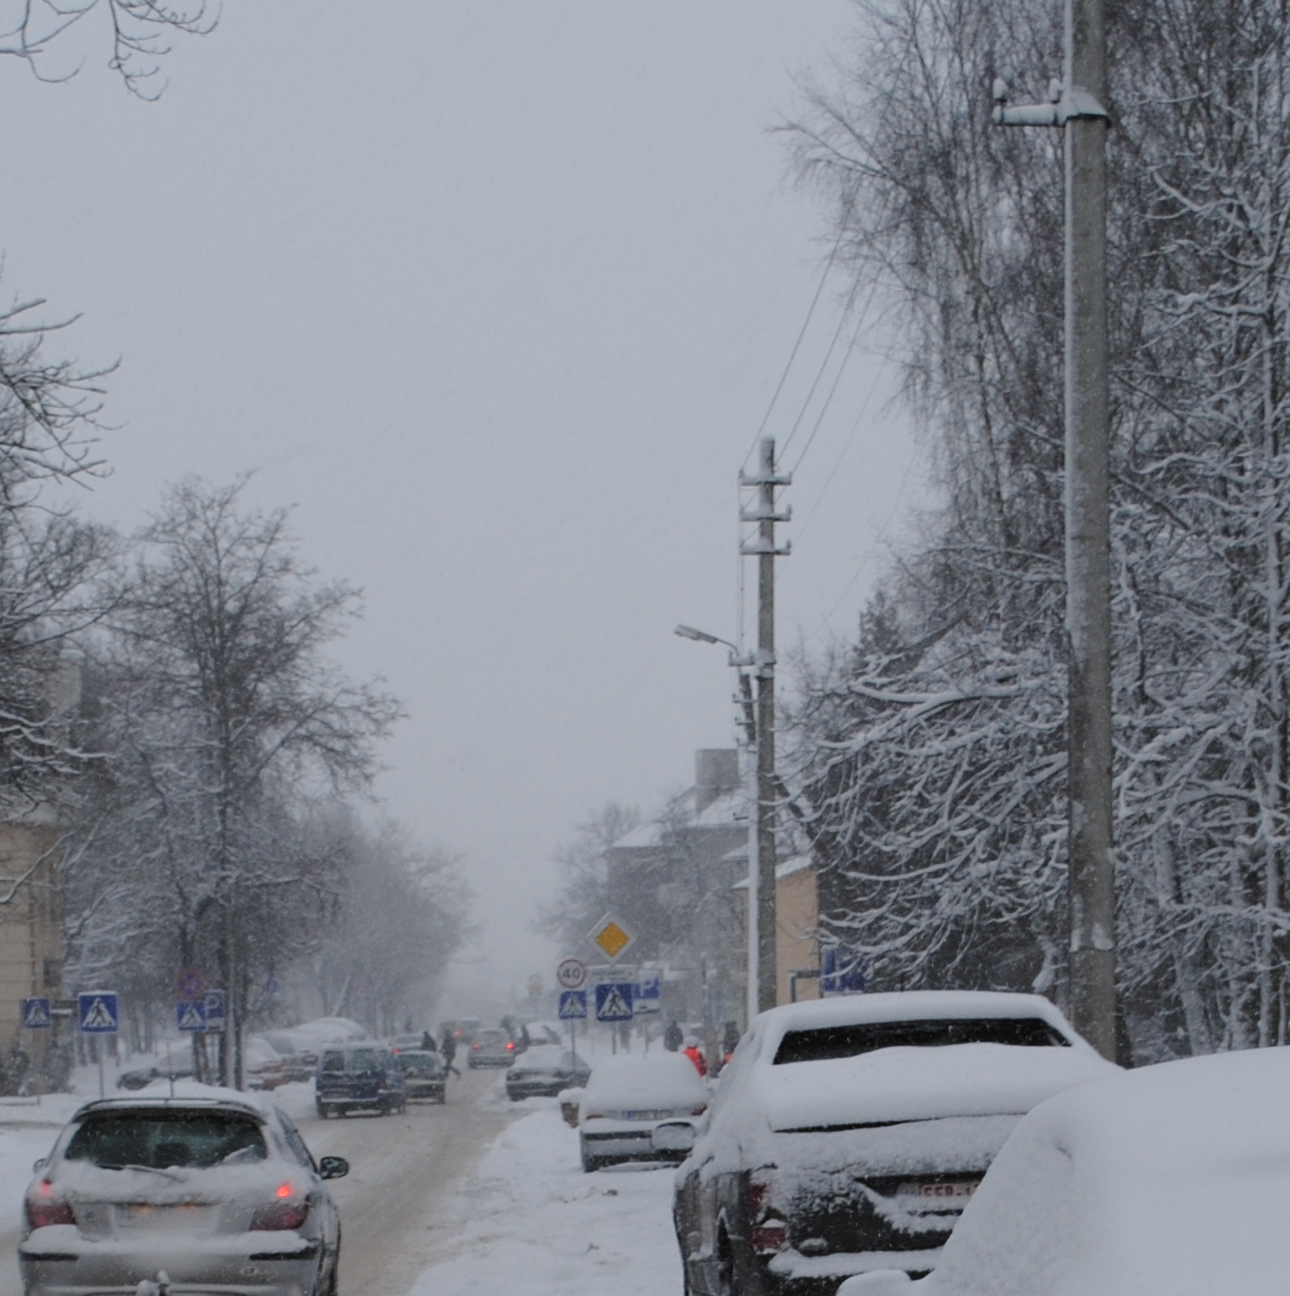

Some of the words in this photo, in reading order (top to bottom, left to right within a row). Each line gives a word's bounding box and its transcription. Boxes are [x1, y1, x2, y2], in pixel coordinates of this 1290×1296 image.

[562, 967, 581, 979] 40
[640, 976, 656, 996] P
[205, 995, 220, 1018] P
